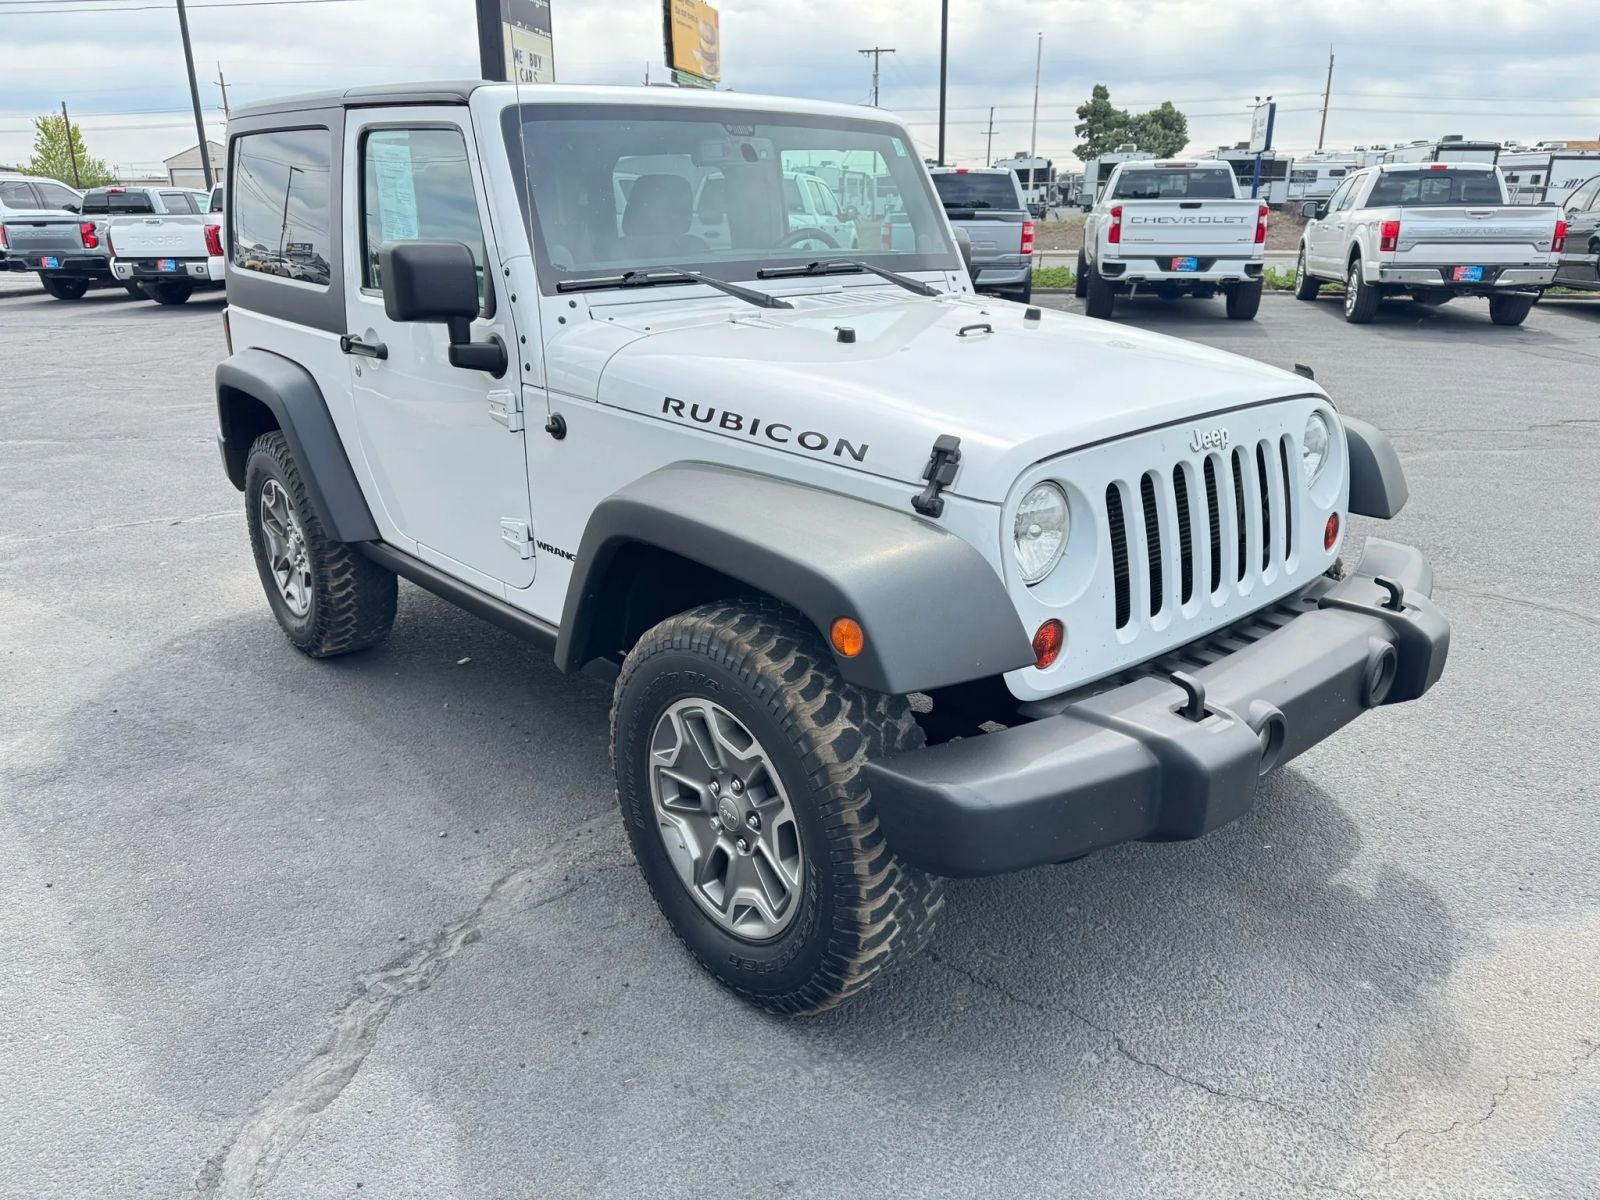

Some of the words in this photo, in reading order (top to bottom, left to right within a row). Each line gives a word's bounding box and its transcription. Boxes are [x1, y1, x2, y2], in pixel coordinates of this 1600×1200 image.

[512, 48, 523, 65] WE
[529, 52, 542, 70] BUY
[520, 67, 539, 83] CARS
[1131, 216, 1248, 224] CHEVROLET
[661, 396, 869, 462] RUBICON
[1190, 428, 1230, 453] Jeep
